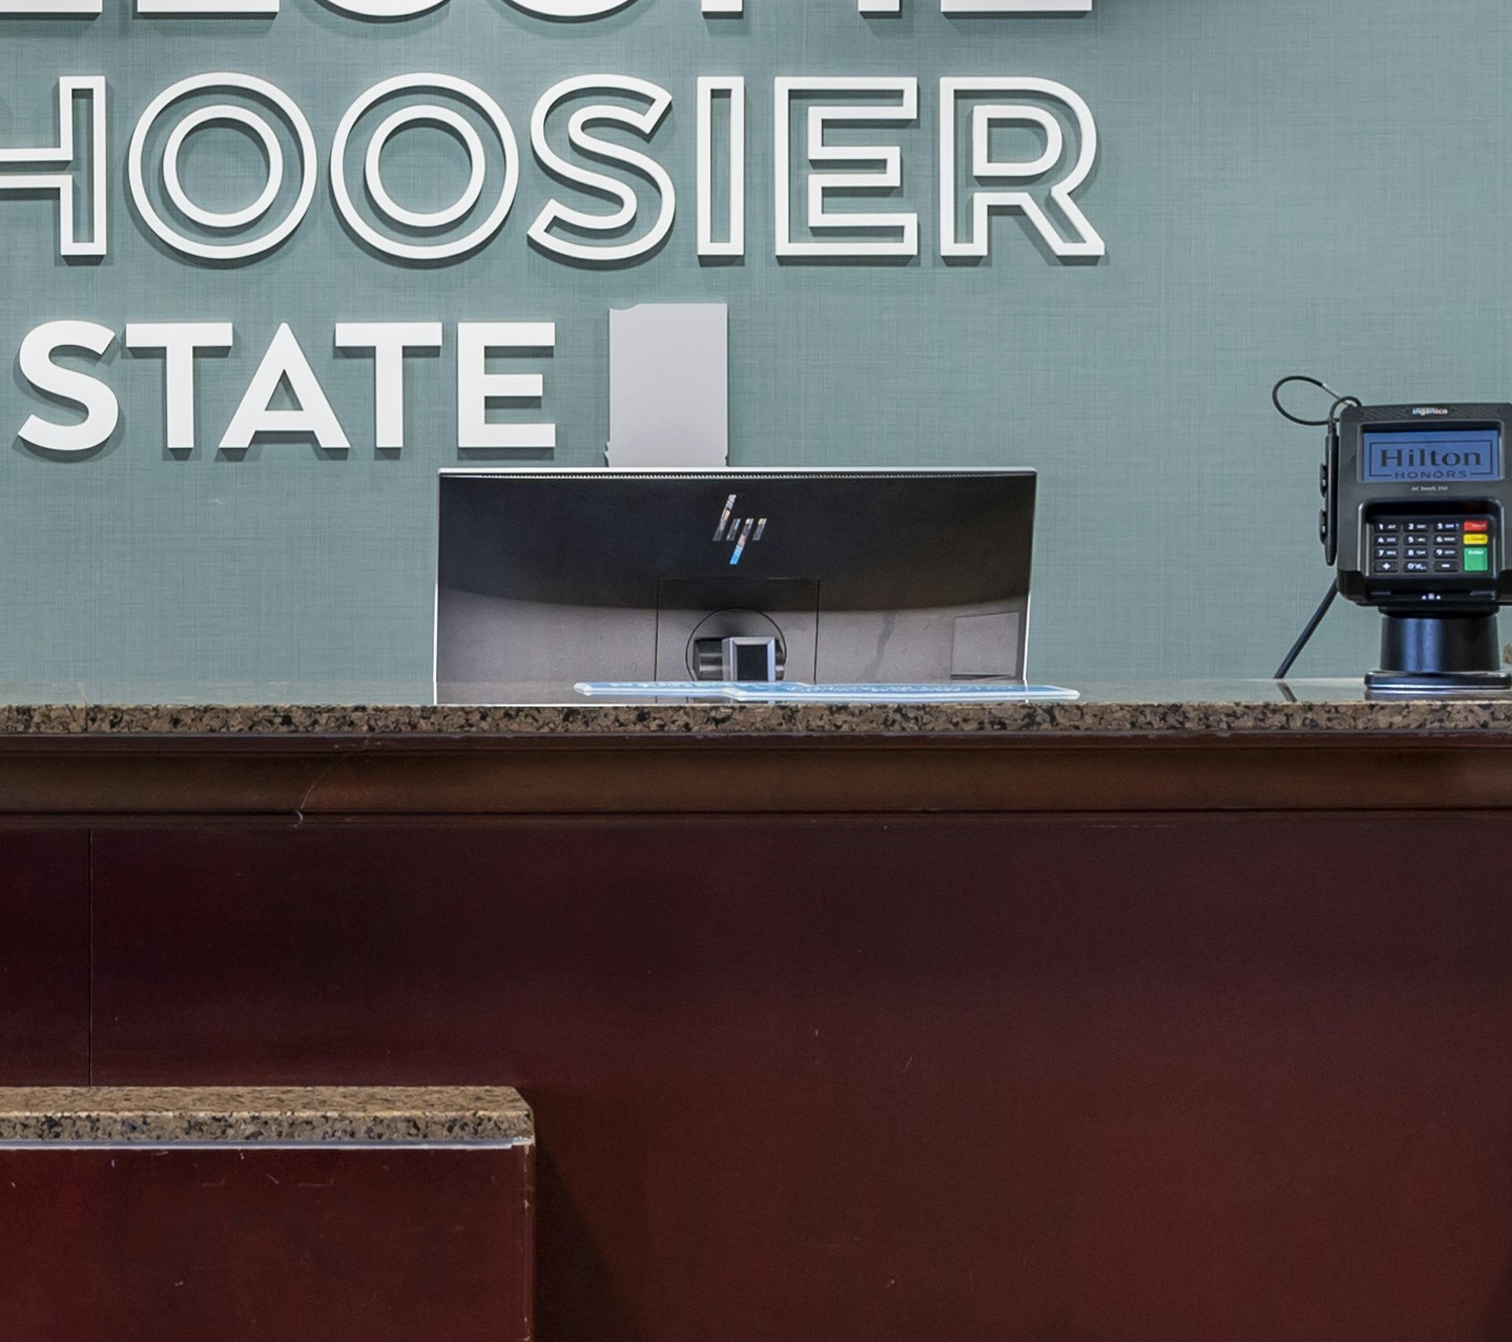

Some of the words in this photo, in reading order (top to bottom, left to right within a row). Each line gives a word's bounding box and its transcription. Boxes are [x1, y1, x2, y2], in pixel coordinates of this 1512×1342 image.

[16, 319, 557, 451] STATE
[1379, 447, 1482, 469] Hilton
[1394, 470, 1468, 480] HONORS
